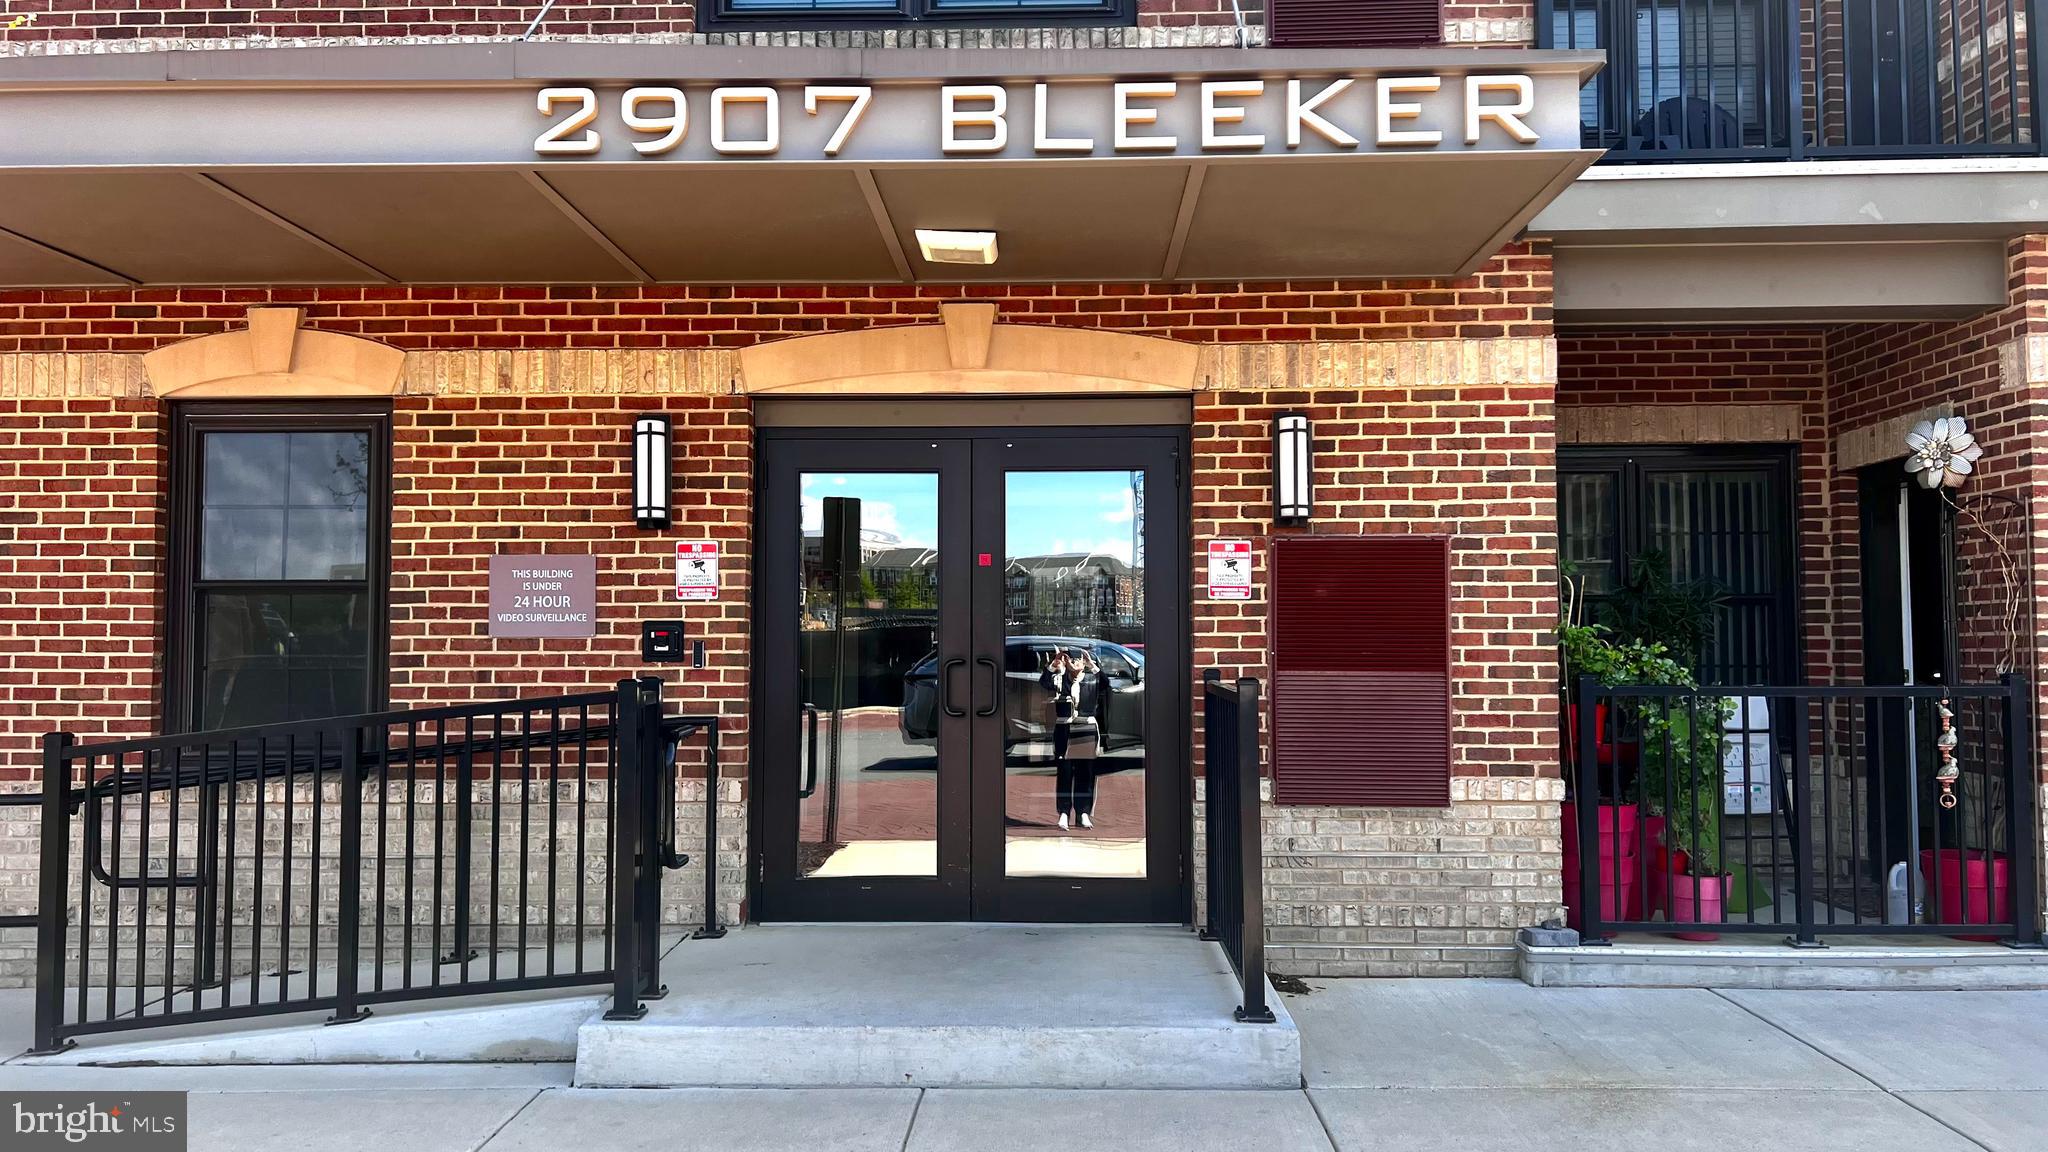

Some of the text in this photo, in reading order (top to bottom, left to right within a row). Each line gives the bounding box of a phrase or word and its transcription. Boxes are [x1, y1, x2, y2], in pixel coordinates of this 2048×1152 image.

[534, 75, 1541, 155] 2907 BLEEKER
[512, 569, 573, 578] THIS BUILDING
[523, 582, 562, 590] IS UNDER
[513, 595, 571, 608] 24 HOUR
[497, 613, 588, 622] VIDEO SURVEILLANCE
